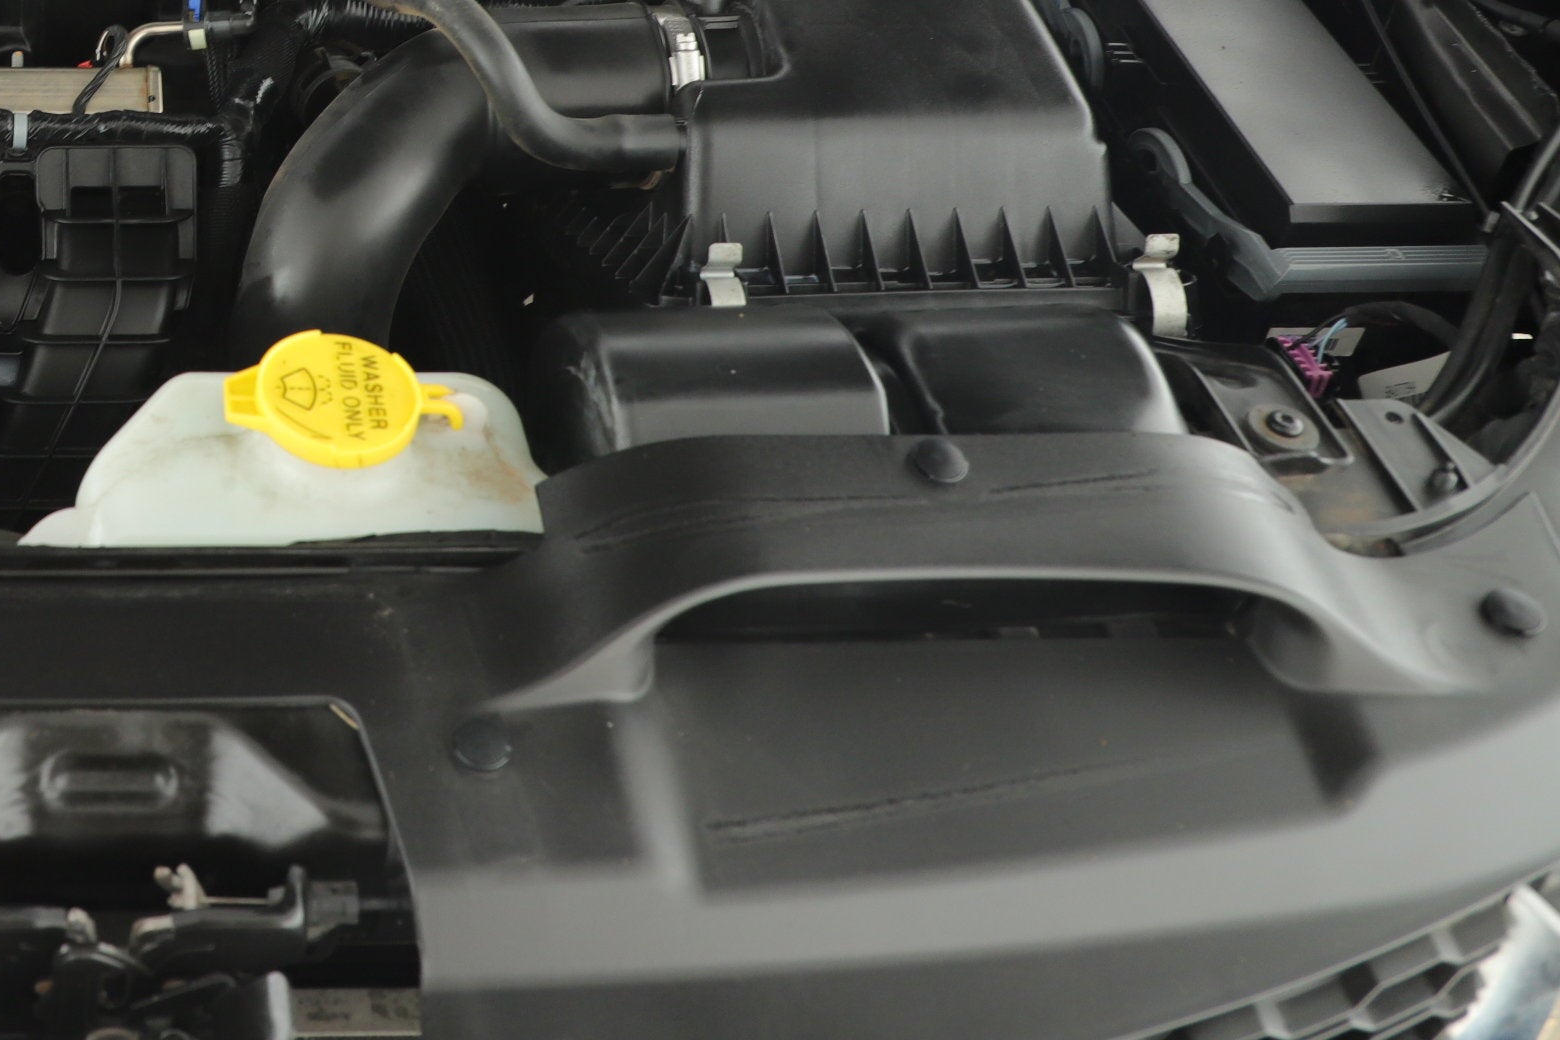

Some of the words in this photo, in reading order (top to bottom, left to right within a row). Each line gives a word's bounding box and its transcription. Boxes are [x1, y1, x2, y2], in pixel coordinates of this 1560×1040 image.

[334, 341, 359, 390] FLUID
[359, 355, 389, 431] WASHER
[342, 396, 367, 442] ONLY
